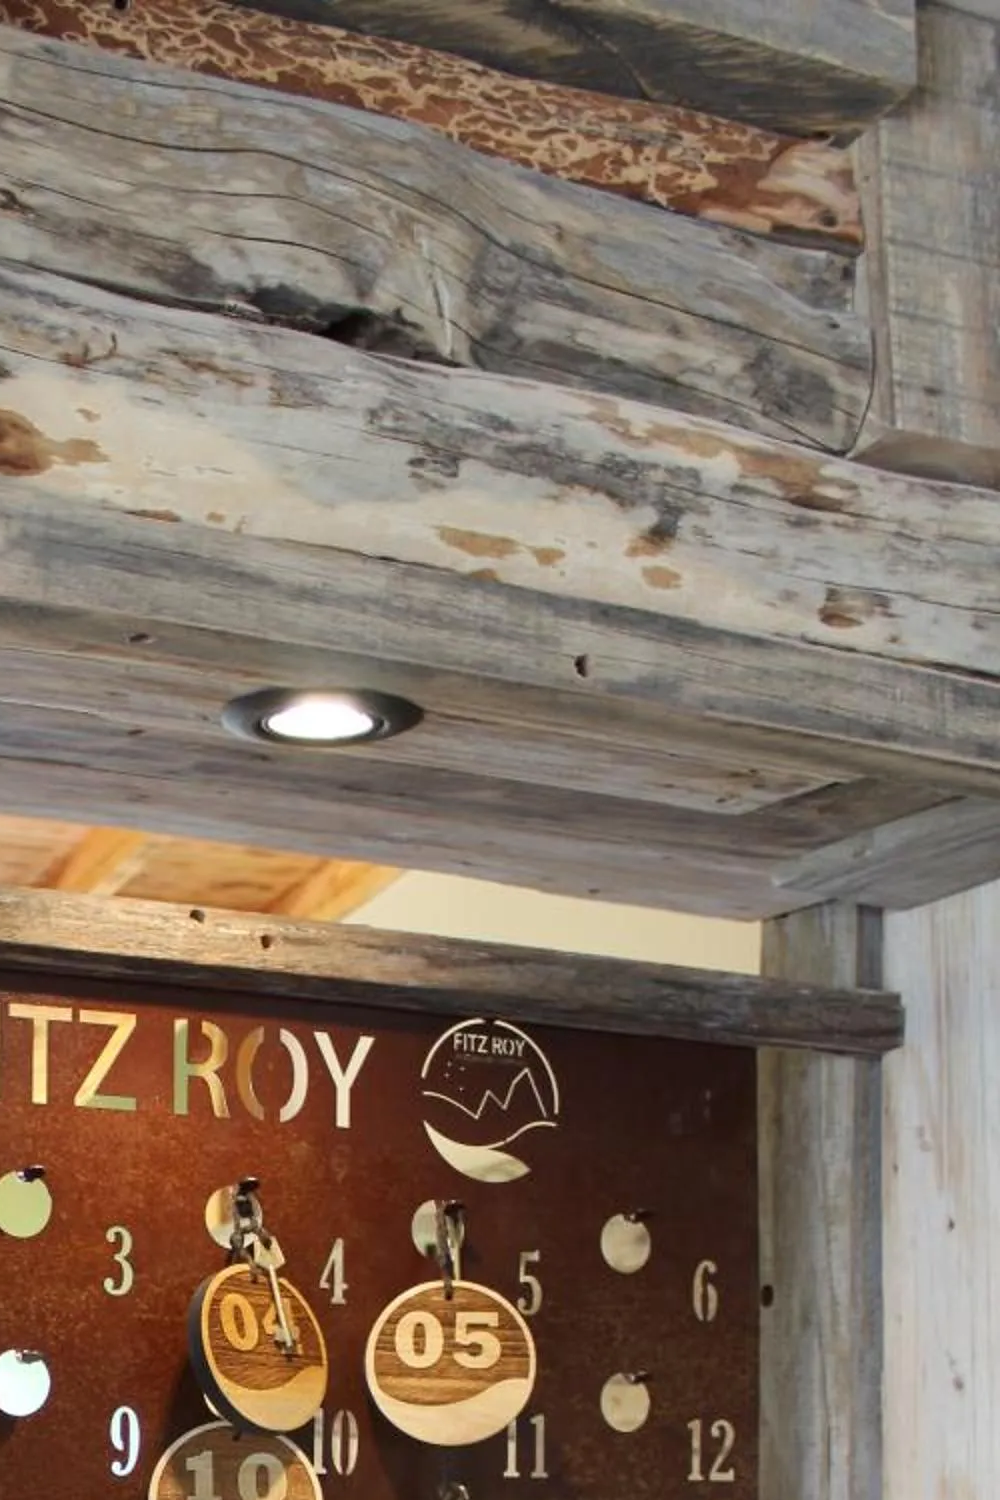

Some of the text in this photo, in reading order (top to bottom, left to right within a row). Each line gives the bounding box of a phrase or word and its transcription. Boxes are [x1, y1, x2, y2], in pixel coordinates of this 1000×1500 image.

[173, 1018, 376, 1129] ROY
[453, 1032, 525, 1057] FITZ ROY
[103, 1226, 134, 1296] 3
[319, 1238, 349, 1305] 4
[516, 1250, 543, 1316] 5
[692, 1259, 718, 1322] 6
[395, 1310, 502, 1369] 05
[109, 1406, 141, 1477] 9
[312, 1407, 359, 1477] 10
[503, 1413, 549, 1479] 11
[686, 1419, 735, 1482] 12
